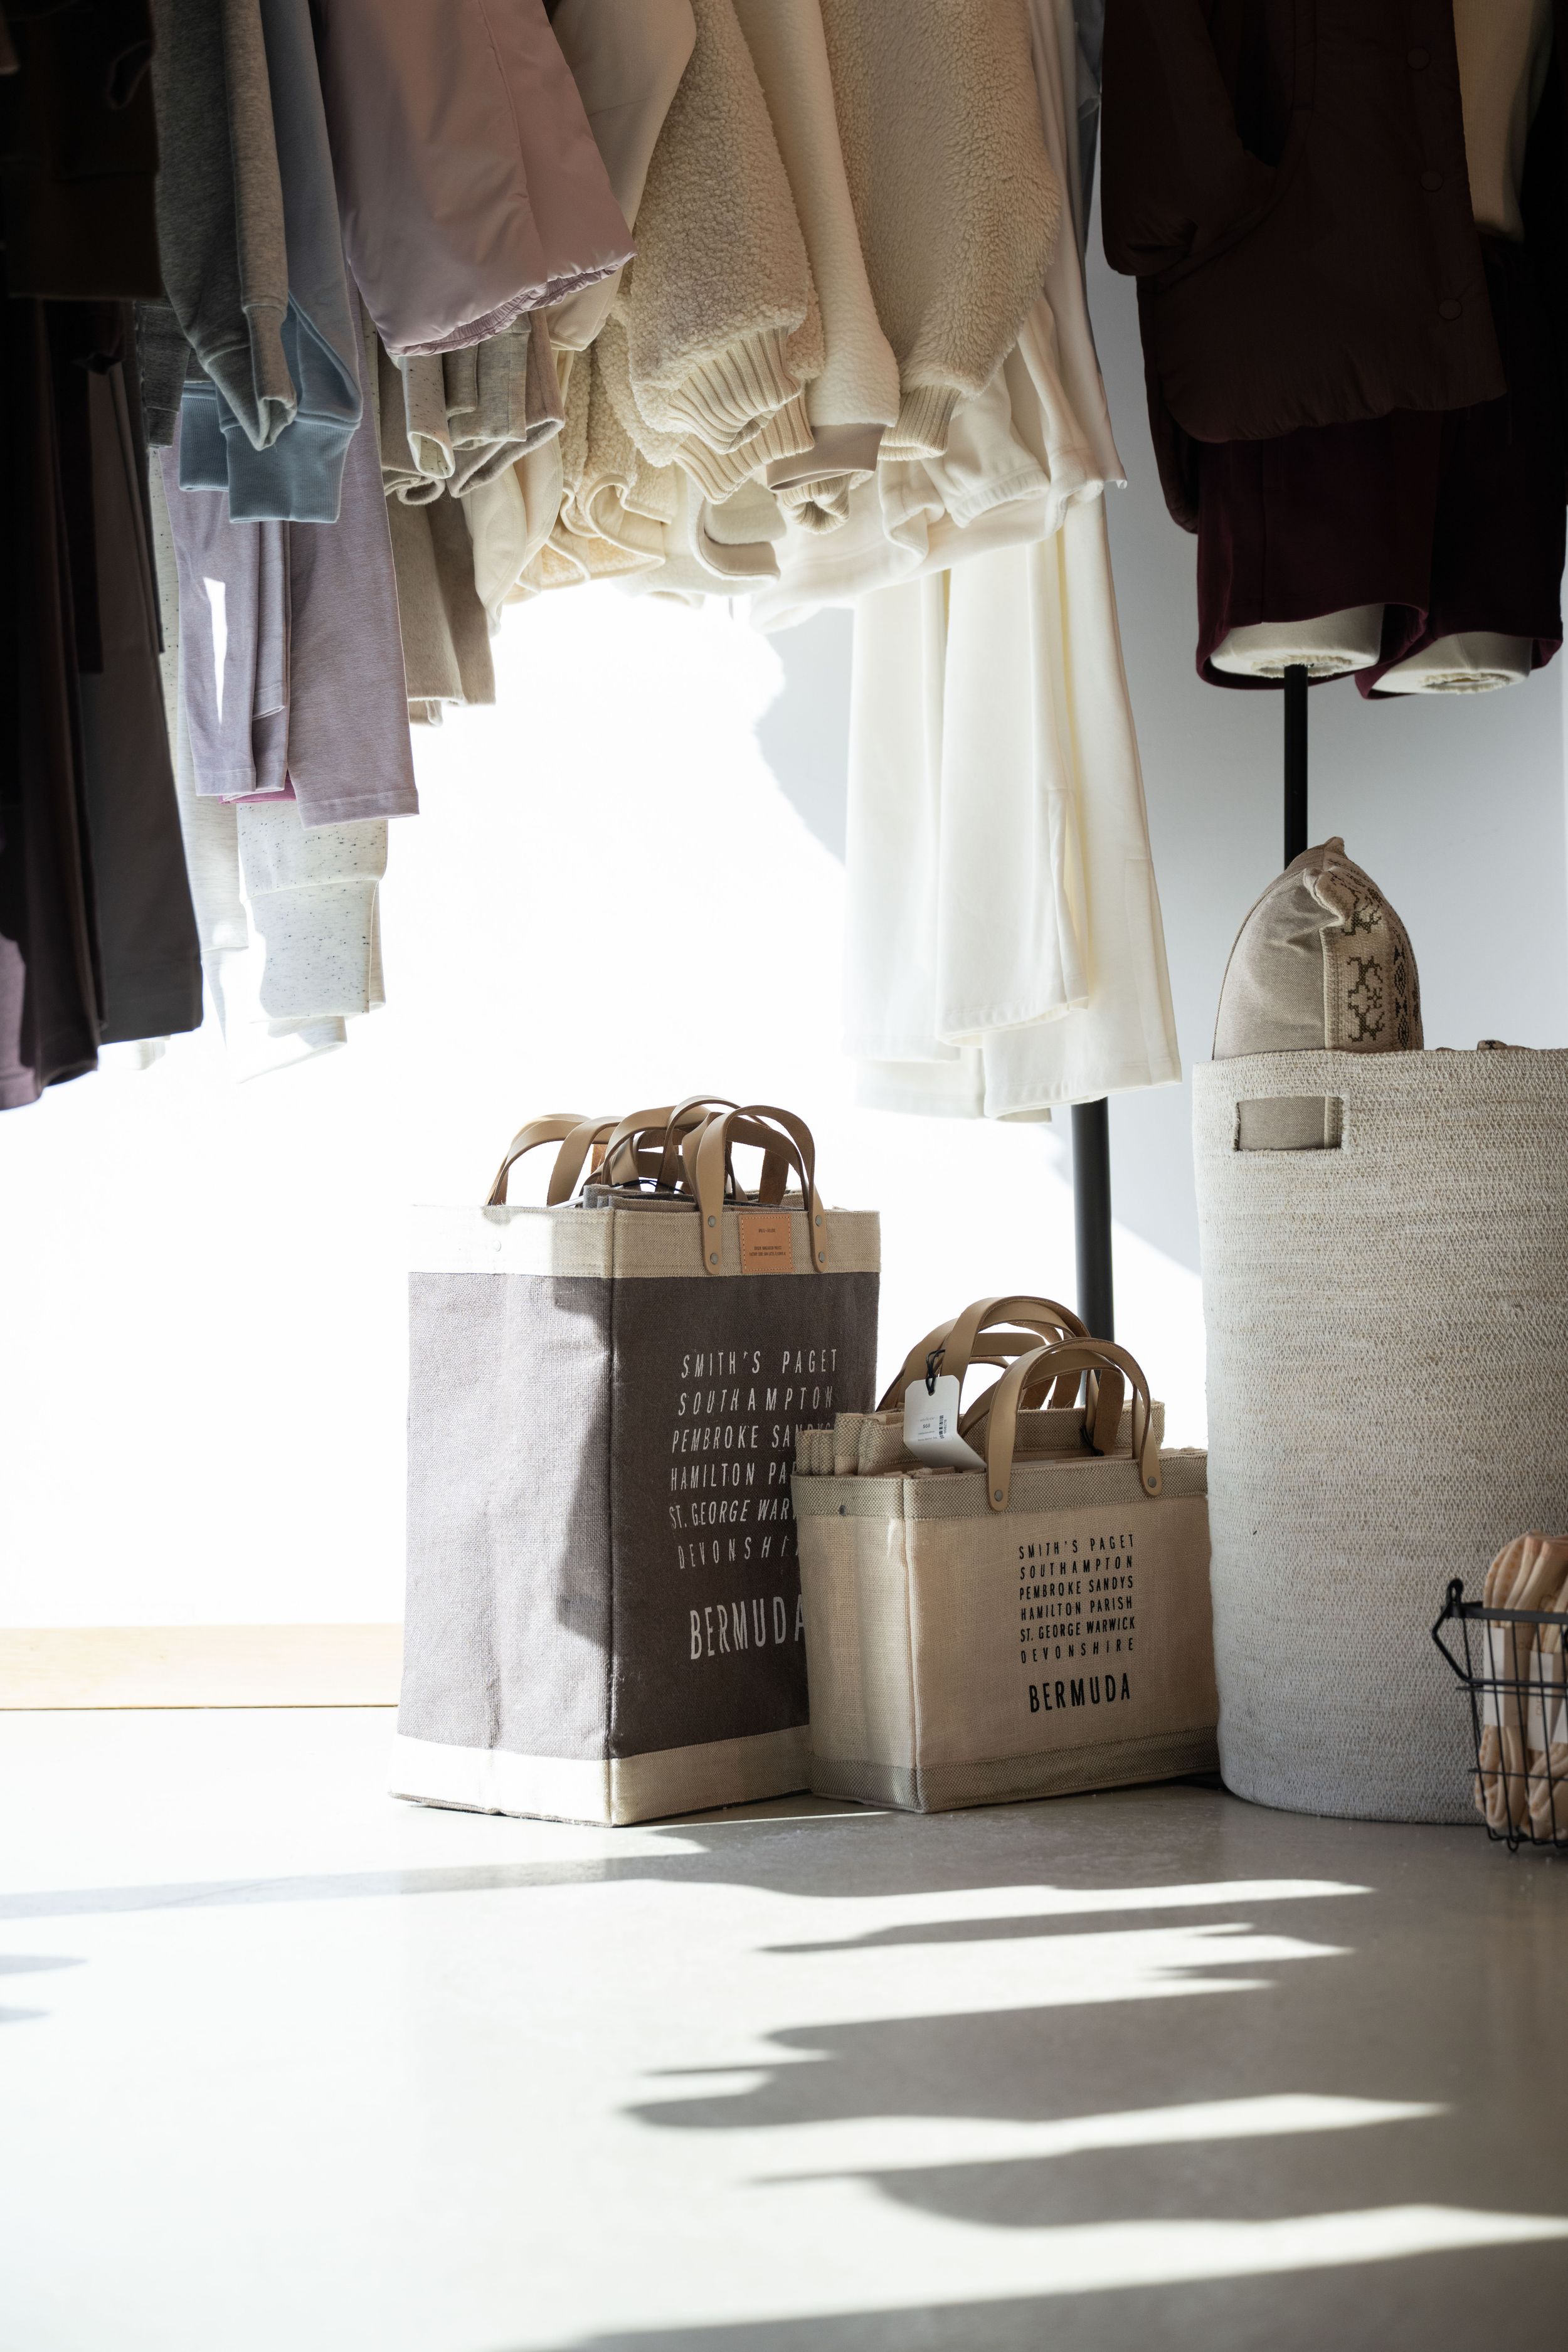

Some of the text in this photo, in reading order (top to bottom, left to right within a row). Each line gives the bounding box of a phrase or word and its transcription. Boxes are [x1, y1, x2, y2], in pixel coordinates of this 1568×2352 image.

[682, 1349, 837, 1378] SMITH'S PAGET
[678, 1385, 834, 1416] SOUTHAMPTON
[672, 1425, 759, 1453] PEMBROKE
[670, 1462, 755, 1491] HAMILTON
[669, 1505, 687, 1529] ST.
[691, 1500, 751, 1526] GEORGE
[678, 1535, 798, 1569] DEVONSHI
[1019, 1534, 1133, 1560] SMITH'S PAGET
[1020, 1555, 1132, 1580] SOUTHAMPTON
[1020, 1575, 1133, 1600] PEMBROKE SANDYS
[1021, 1596, 1132, 1621] HAMILTON PARISH
[690, 1594, 805, 1660] BERMUDA
[1020, 1616, 1135, 1642] ST. GEORGE WARWICK
[1021, 1637, 1133, 1663] DEVONSHIRE
[1029, 1673, 1130, 1713] BERMUDA
